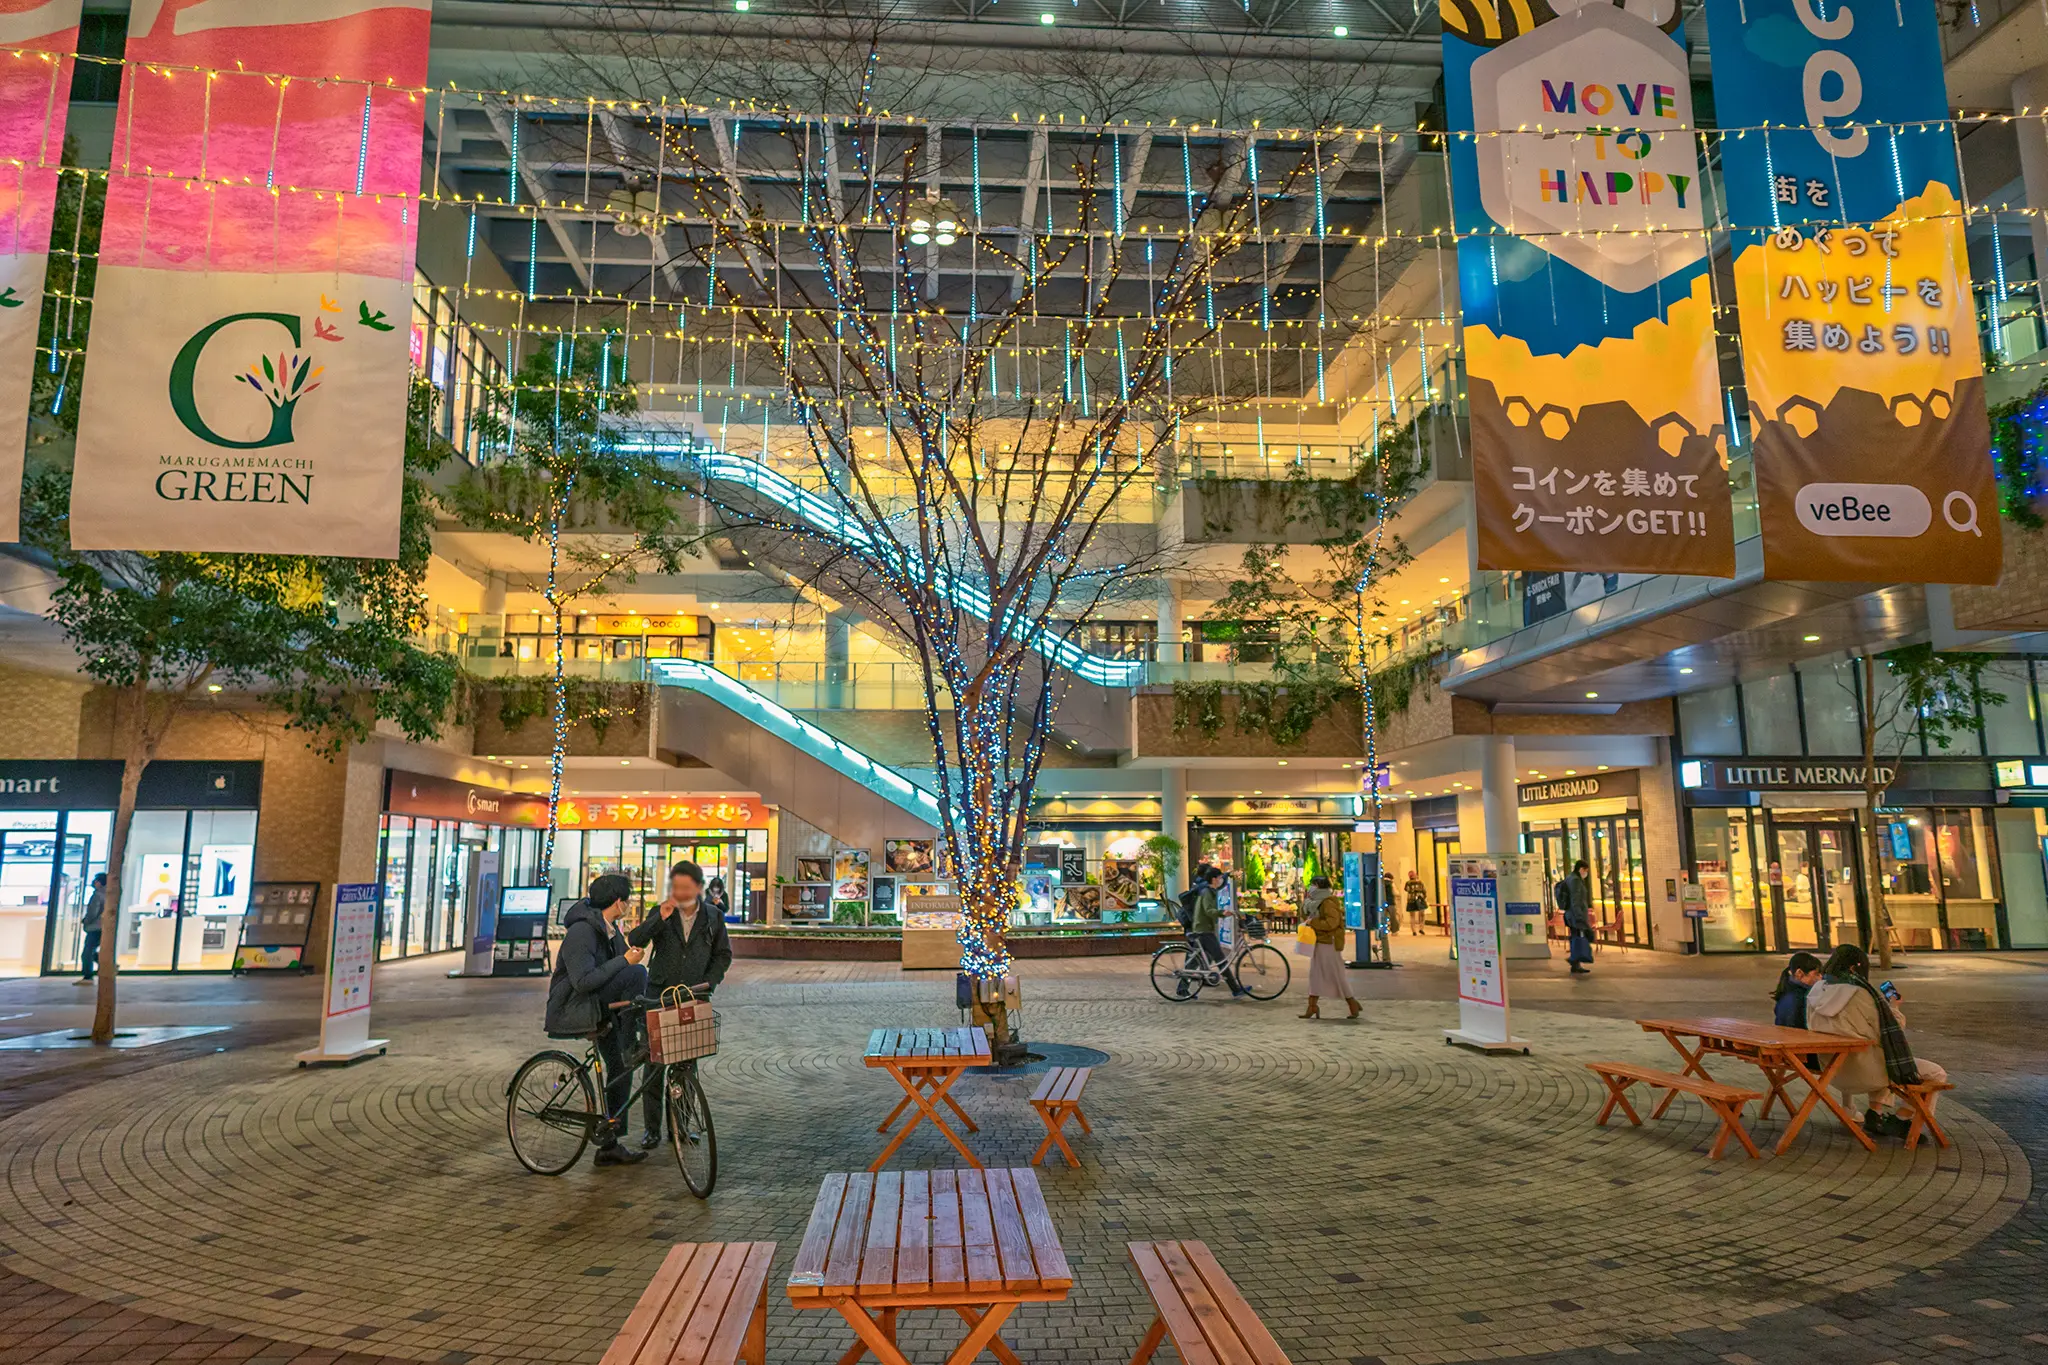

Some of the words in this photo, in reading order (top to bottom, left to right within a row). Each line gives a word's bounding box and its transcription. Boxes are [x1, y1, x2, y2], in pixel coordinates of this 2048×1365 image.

[1541, 79, 1678, 119] MOVE
[1586, 127, 1652, 160] TO
[1539, 169, 1691, 208] HAPPY
[1772, 175, 1829, 207] 街を
[1776, 226, 1899, 257] めぐって
[1781, 275, 1942, 308] ハッピーを
[1784, 320, 1951, 355] 集めよう!!
[159, 455, 313, 470] MARUGAMEMACHI
[155, 469, 315, 505] GREEN
[1512, 466, 1699, 498] コインを集めて
[1512, 503, 1707, 537] クーポンGET!!
[1810, 496, 1891, 522] veBee
[1522, 785, 1549, 802] LITTLE
[1550, 779, 1599, 798] MERMAID
[1726, 767, 1789, 784] LITTLE
[357, 886, 376, 900] SALE
[1471, 882, 1491, 896] SALE
